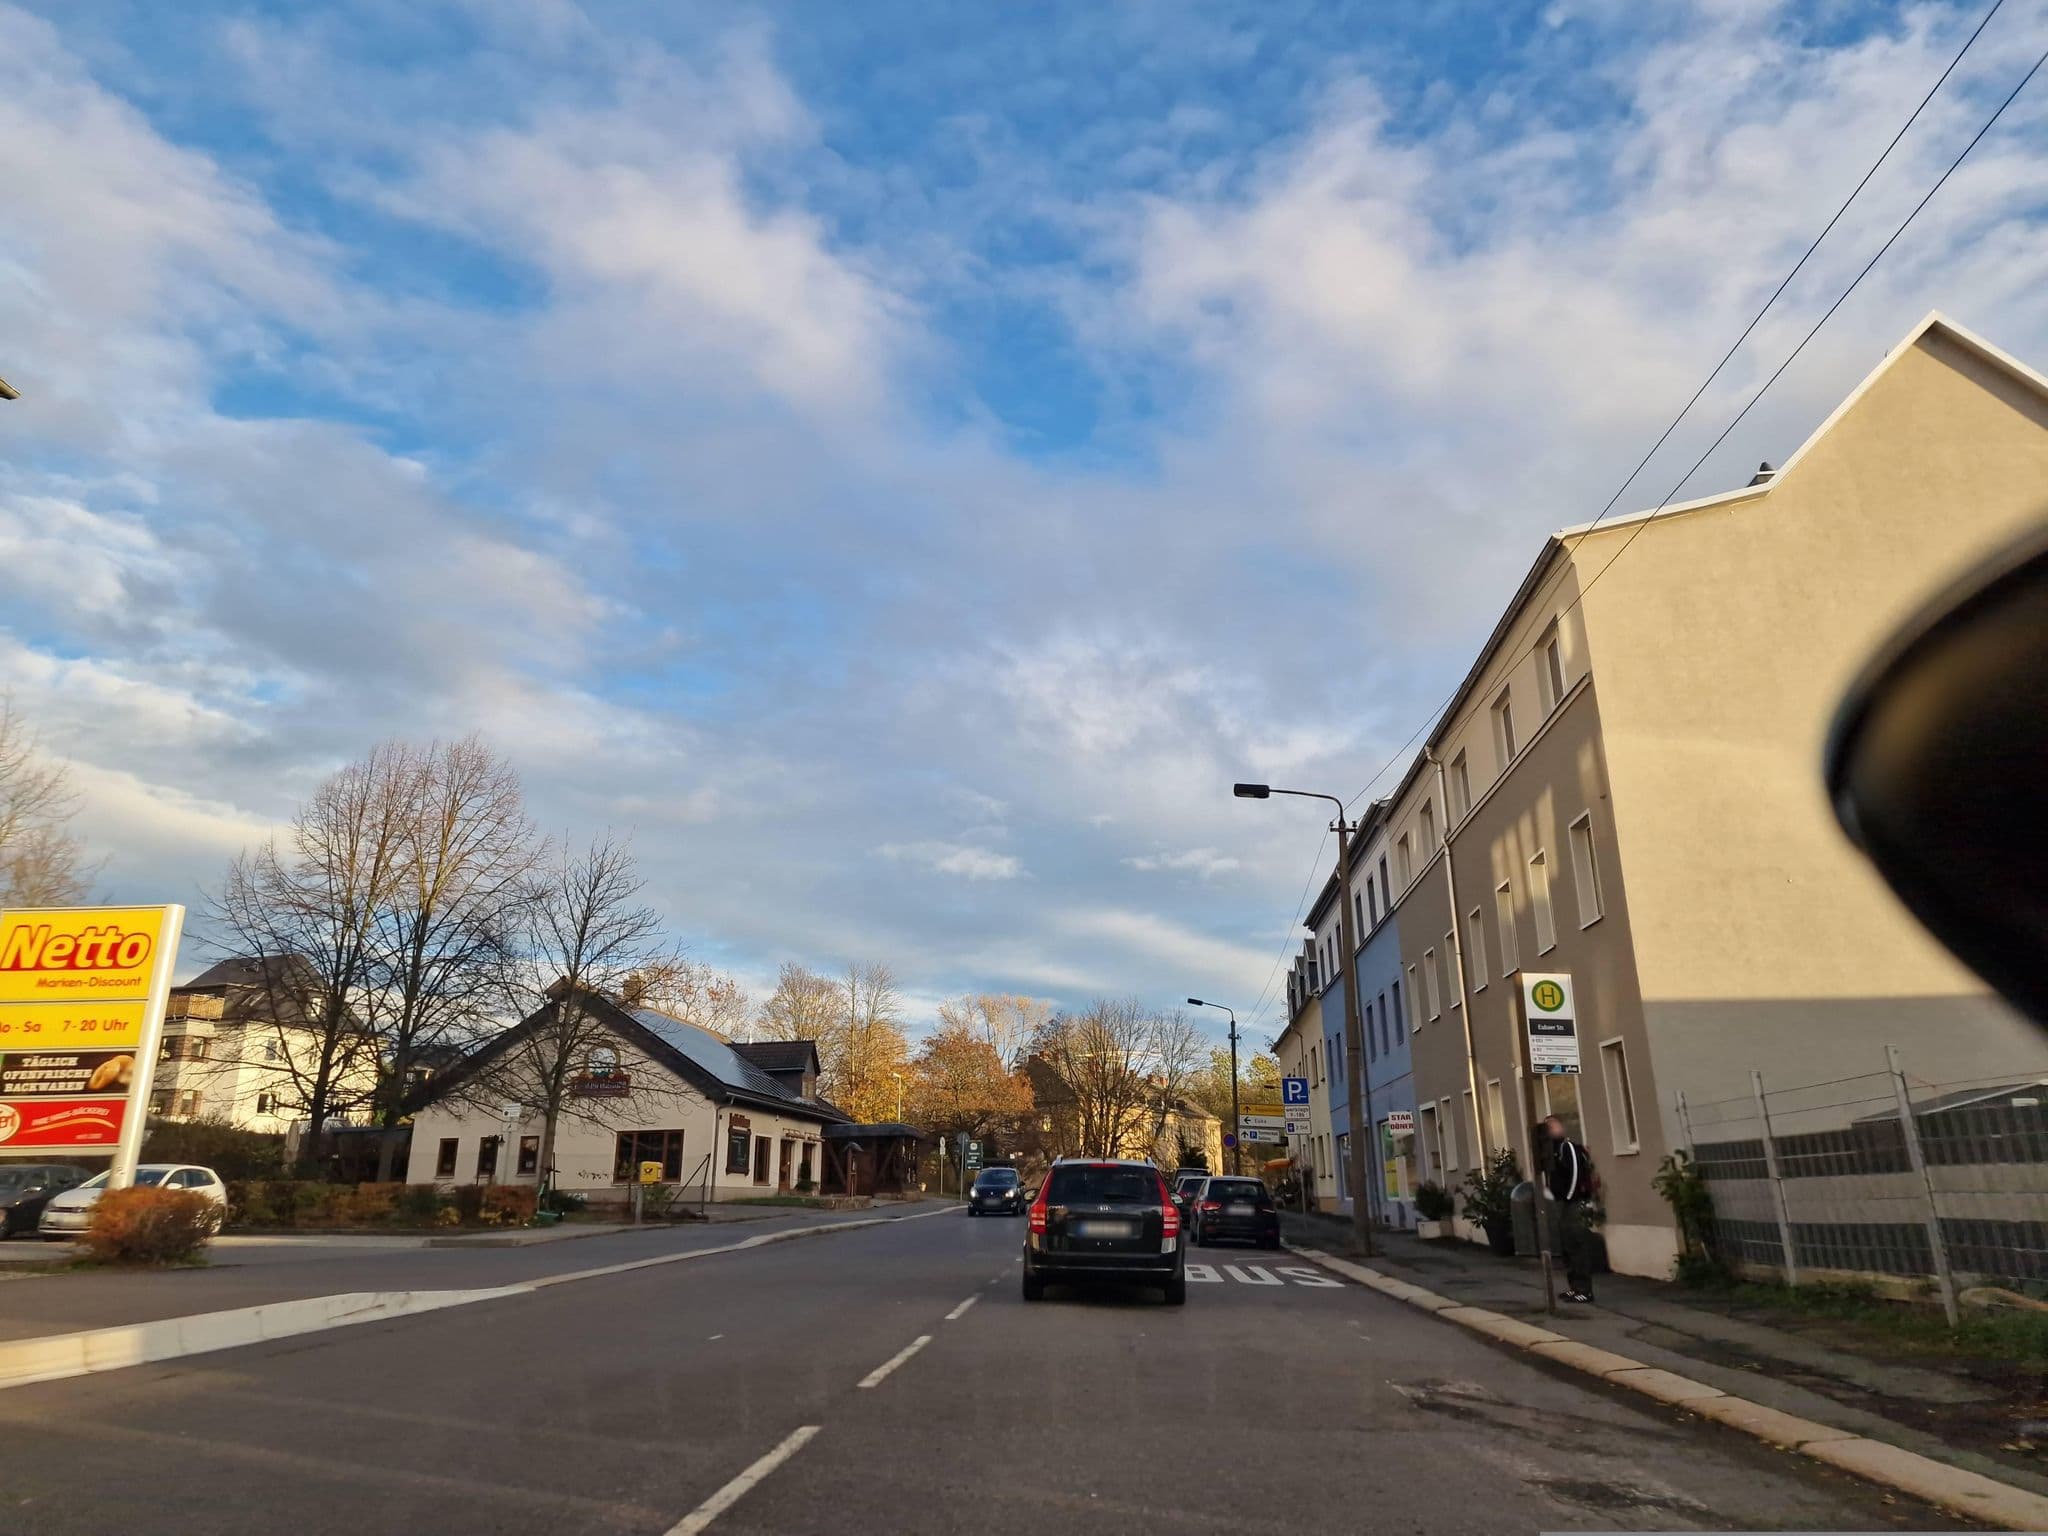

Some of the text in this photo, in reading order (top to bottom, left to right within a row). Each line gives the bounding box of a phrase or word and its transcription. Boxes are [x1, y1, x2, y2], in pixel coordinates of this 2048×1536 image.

[0, 924, 152, 971] Netto
[36, 976, 142, 988] Marken-Discount
[1541, 986, 1556, 1005] H
[0, 1022, 11, 1033] o
[23, 1020, 42, 1033] Sa
[79, 1019, 97, 1032] 20
[102, 1019, 129, 1032] Uhr
[22, 1055, 79, 1067] TÄGLICH
[3, 1069, 92, 1080] OFENFRISCHE
[4, 1081, 86, 1092] BACKWAREN
[1288, 1081, 1302, 1101] P
[1184, 1264, 1347, 1288] BUS
